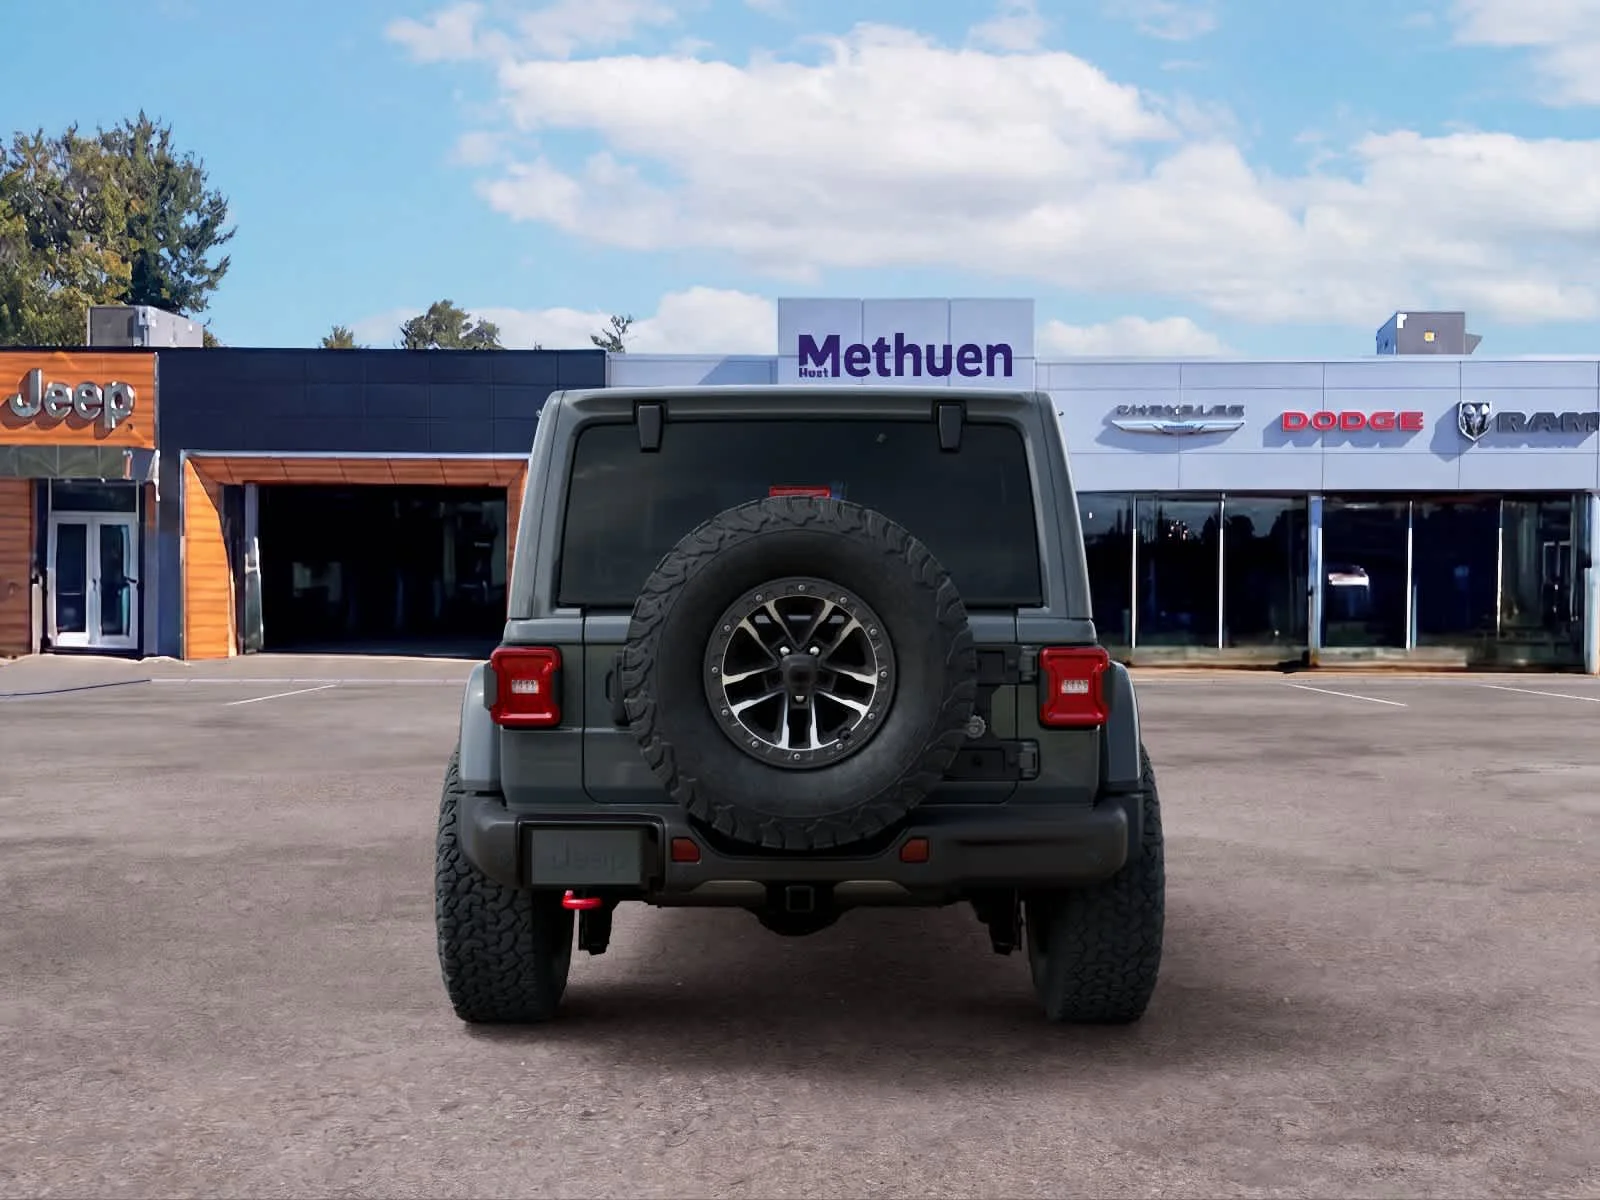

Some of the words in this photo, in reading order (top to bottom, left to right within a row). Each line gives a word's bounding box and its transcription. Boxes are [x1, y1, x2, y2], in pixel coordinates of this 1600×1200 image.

[798, 332, 1013, 378] Methuen
[9, 367, 136, 429] Jeep
[1282, 410, 1424, 432] DODGE
[1497, 411, 1600, 433] RAM
